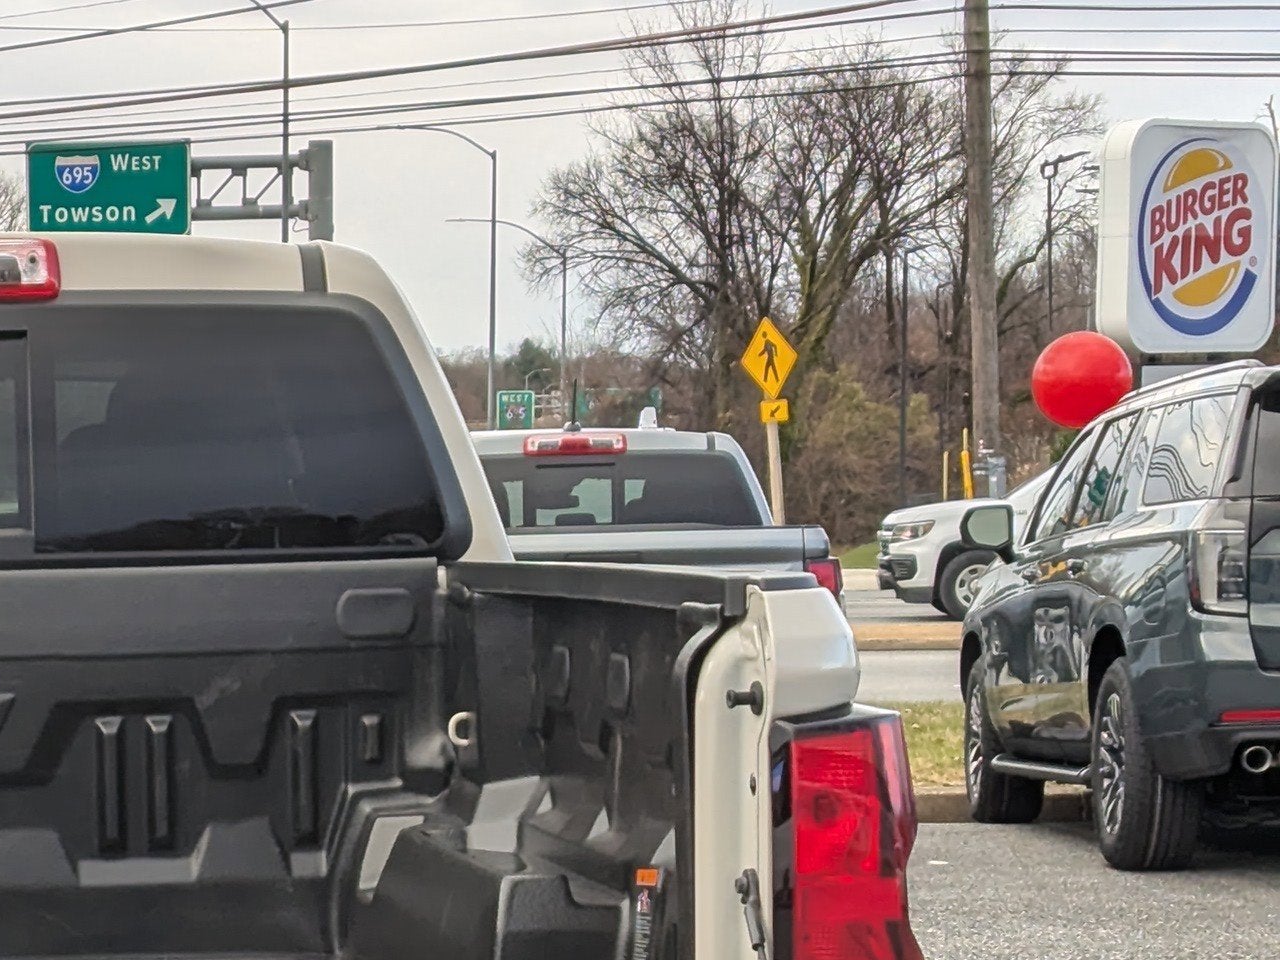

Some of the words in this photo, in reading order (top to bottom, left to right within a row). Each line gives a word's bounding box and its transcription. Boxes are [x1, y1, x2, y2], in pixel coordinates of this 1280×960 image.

[62, 166, 93, 185] 695
[38, 204, 137, 224] Towson
[1150, 173, 1248, 244] BURGER
[1153, 207, 1252, 296] KING
[501, 394, 530, 402] WEST
